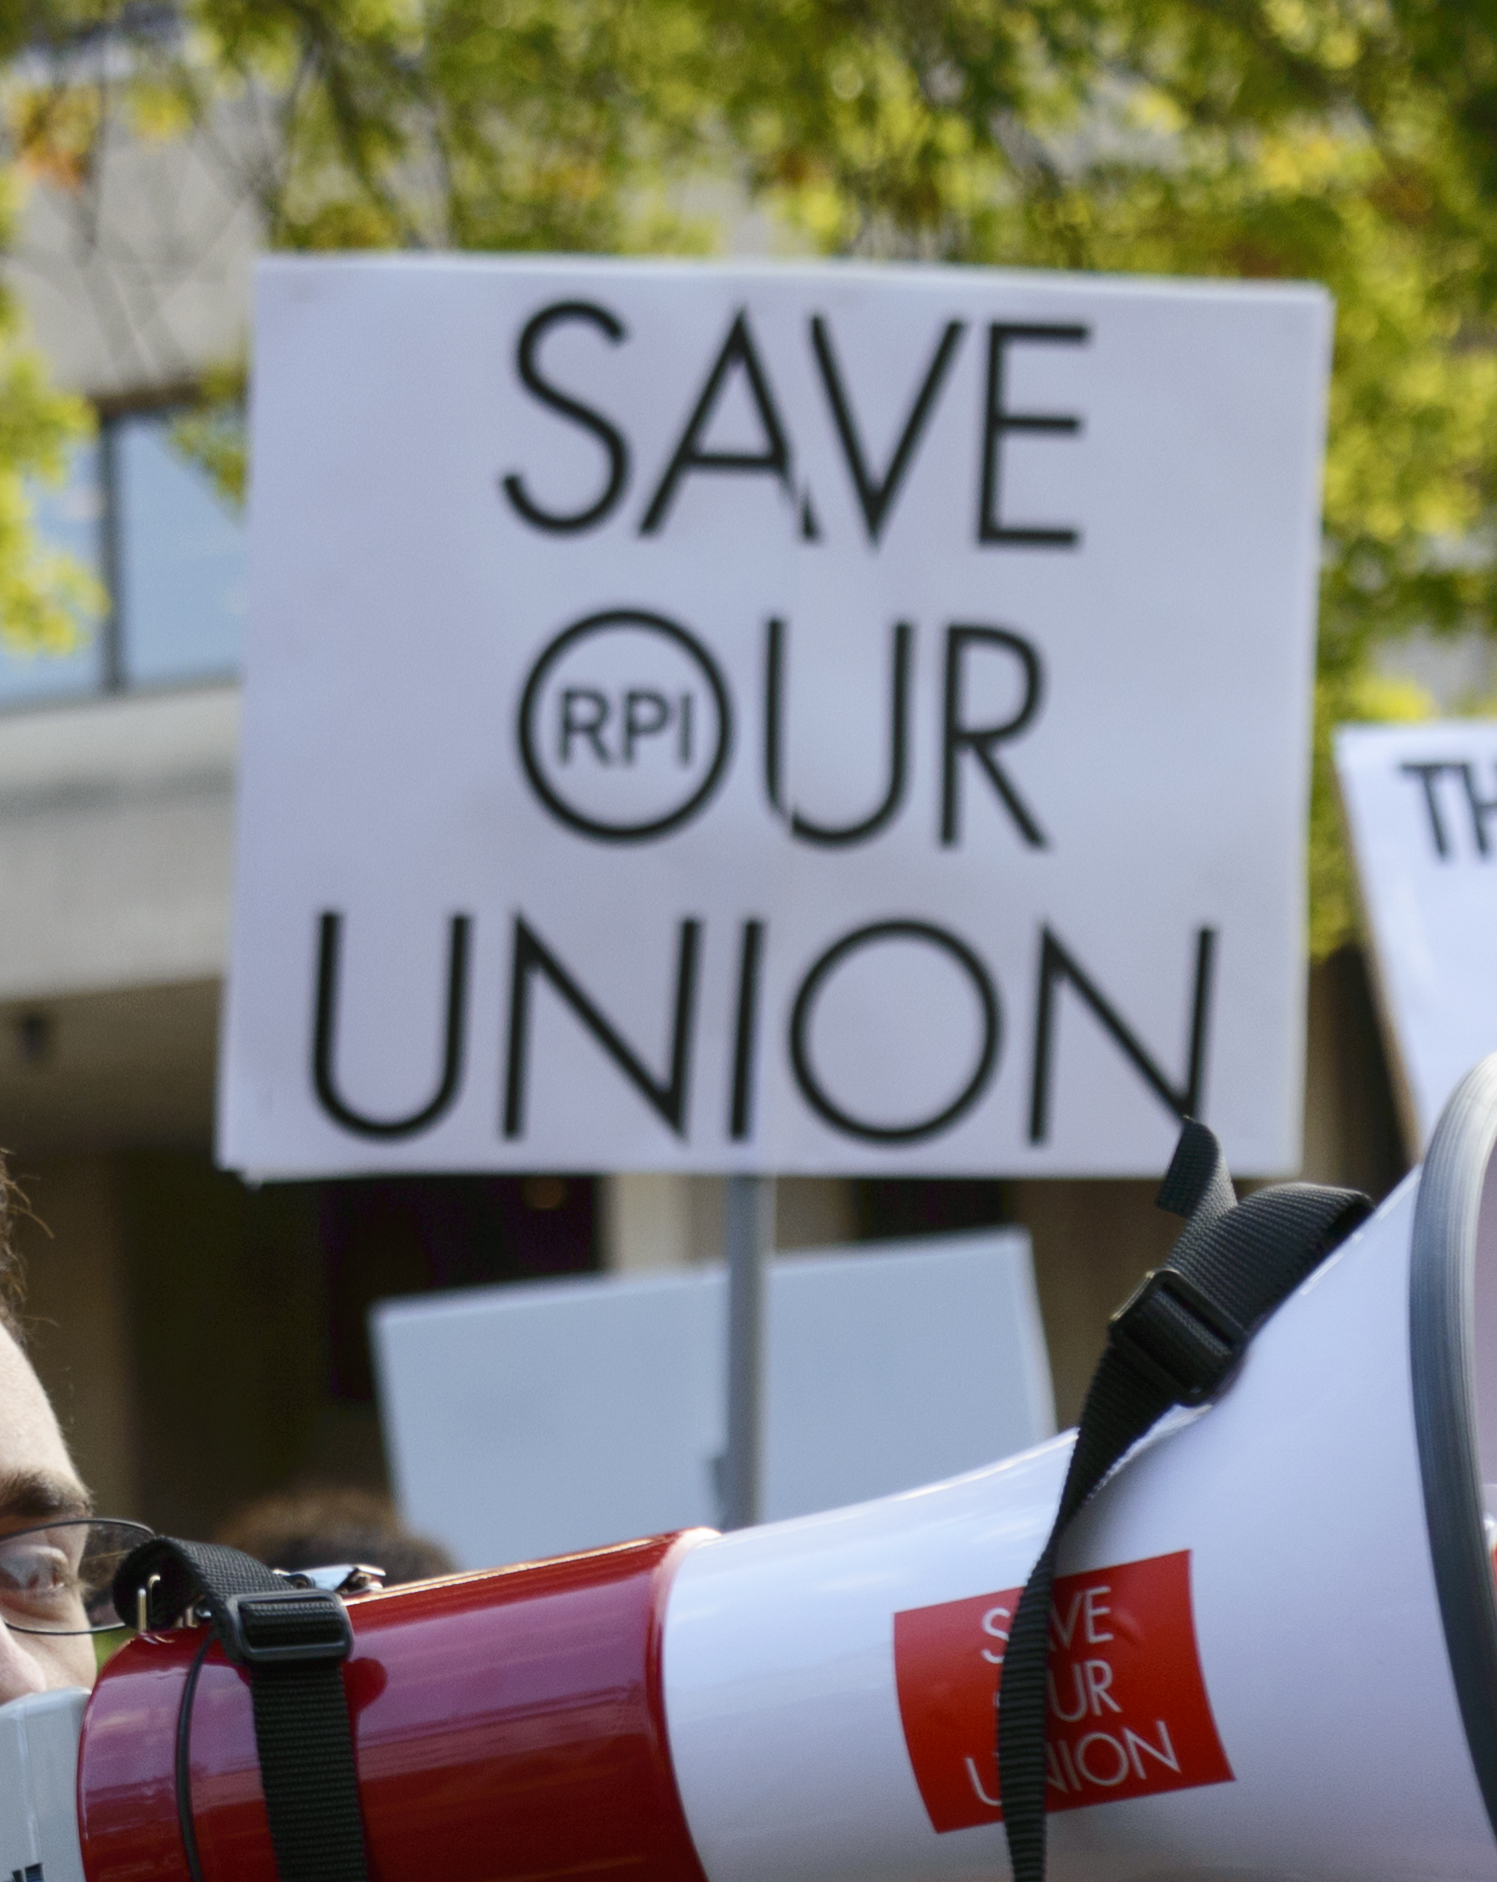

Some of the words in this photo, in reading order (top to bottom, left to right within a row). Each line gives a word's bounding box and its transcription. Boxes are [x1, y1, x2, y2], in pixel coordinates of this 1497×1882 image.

[503, 301, 1091, 549] SAVE
[517, 608, 1050, 849] OUR
[558, 687, 694, 767] RPI
[312, 908, 1217, 1147] UNION
[981, 1585, 1114, 1664] SVE
[993, 1659, 1122, 1722] UR
